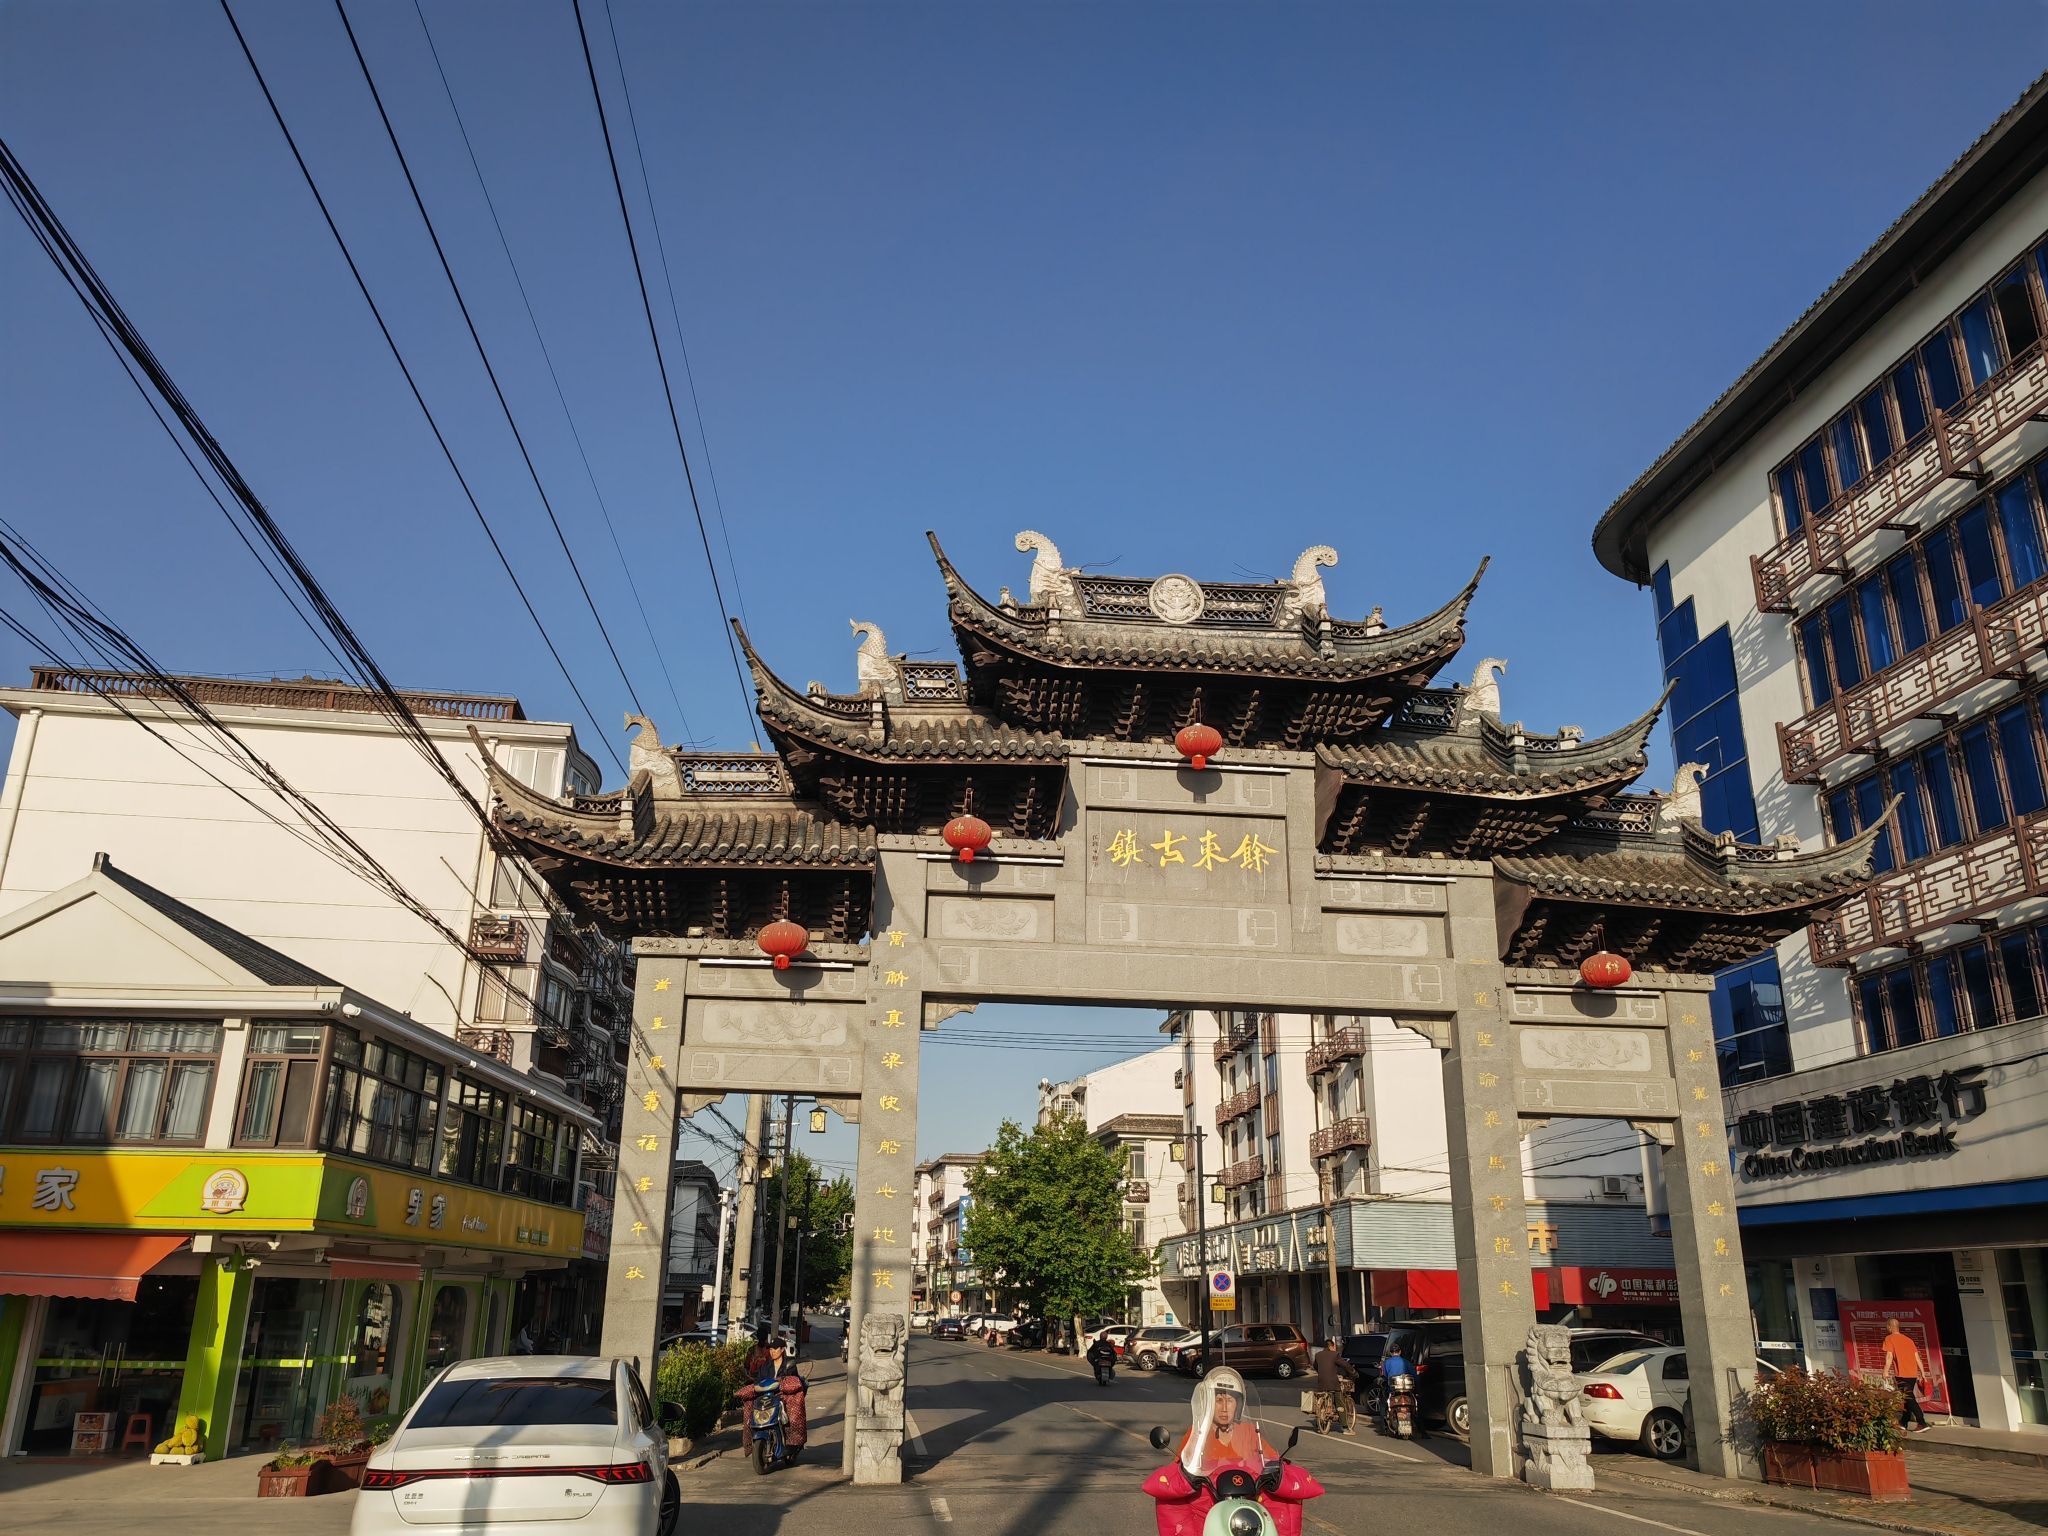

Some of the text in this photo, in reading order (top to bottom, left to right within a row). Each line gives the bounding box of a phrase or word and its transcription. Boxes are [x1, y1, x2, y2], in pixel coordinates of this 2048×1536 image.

[1744, 1126, 1960, 1178] China Construction Bank
[404, 1187, 447, 1231] 果家
